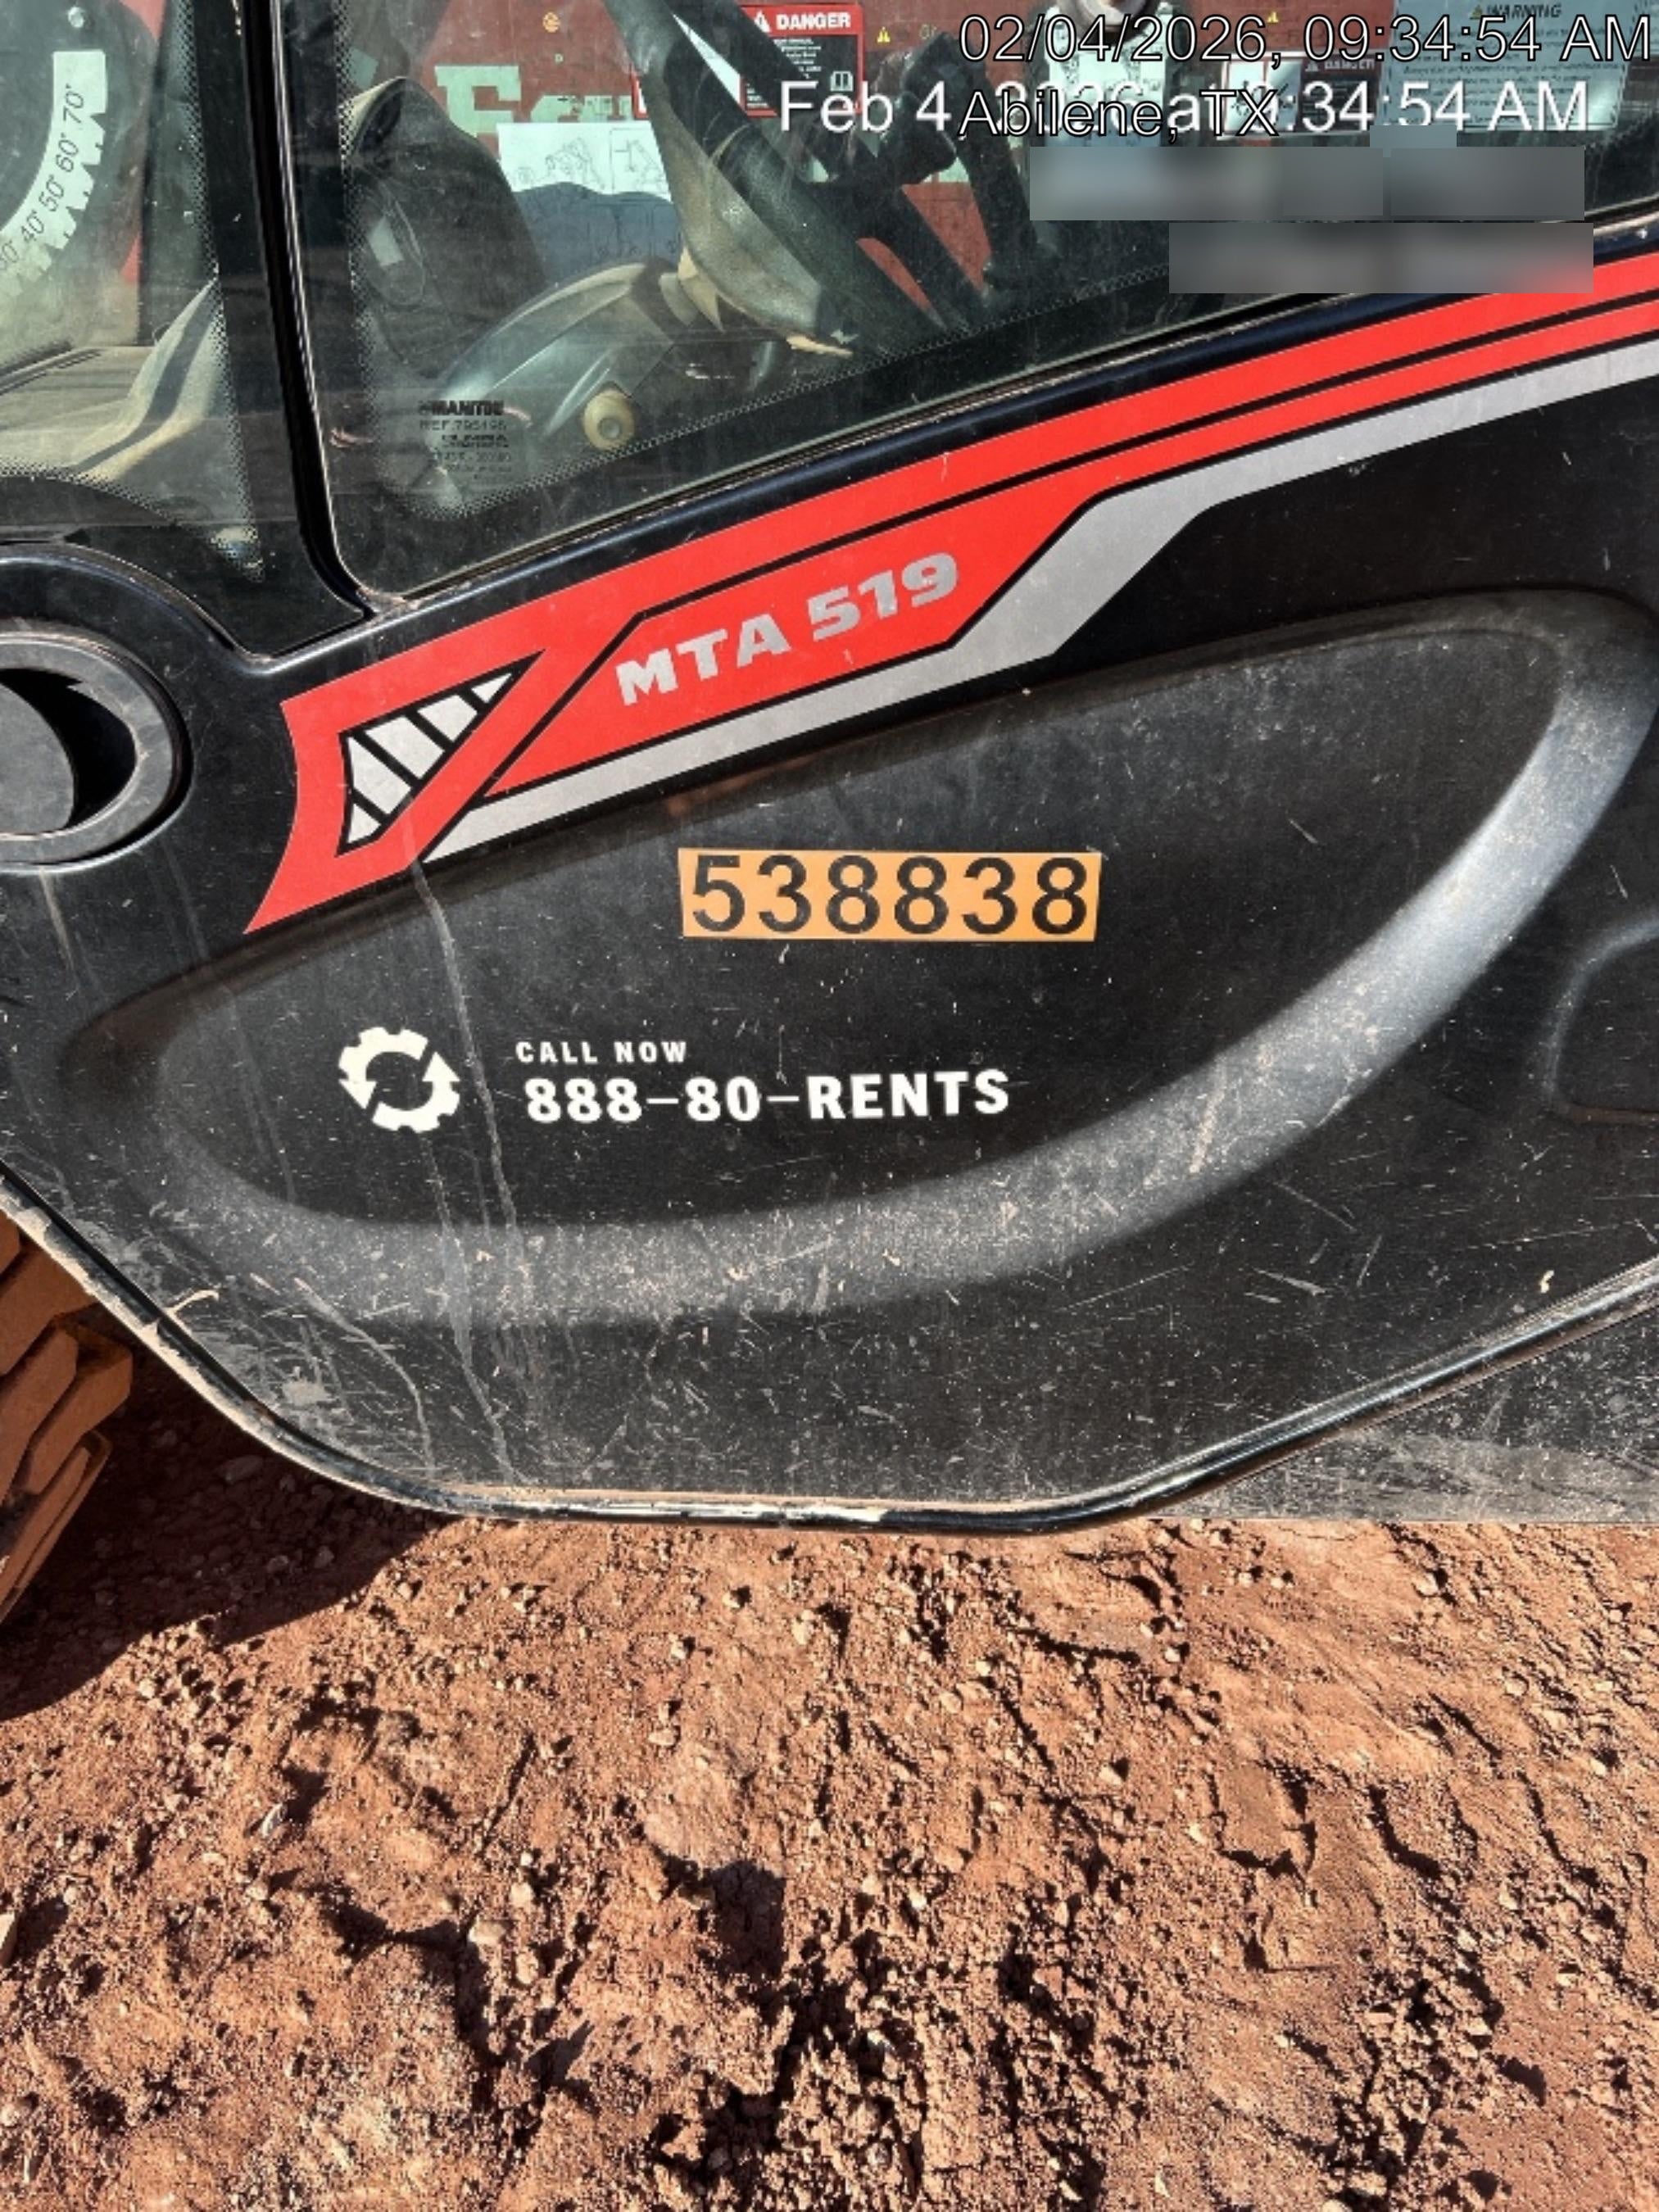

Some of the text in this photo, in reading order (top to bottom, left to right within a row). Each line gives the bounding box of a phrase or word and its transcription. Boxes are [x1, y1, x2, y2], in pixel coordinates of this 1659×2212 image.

[776, 11, 851, 30] DANGER
[614, 551, 959, 705] MTA 519
[692, 854, 1087, 936] 538838
[515, 1040, 688, 1064] CALL NOW
[524, 1068, 1010, 1124] 888-80-RENTS
